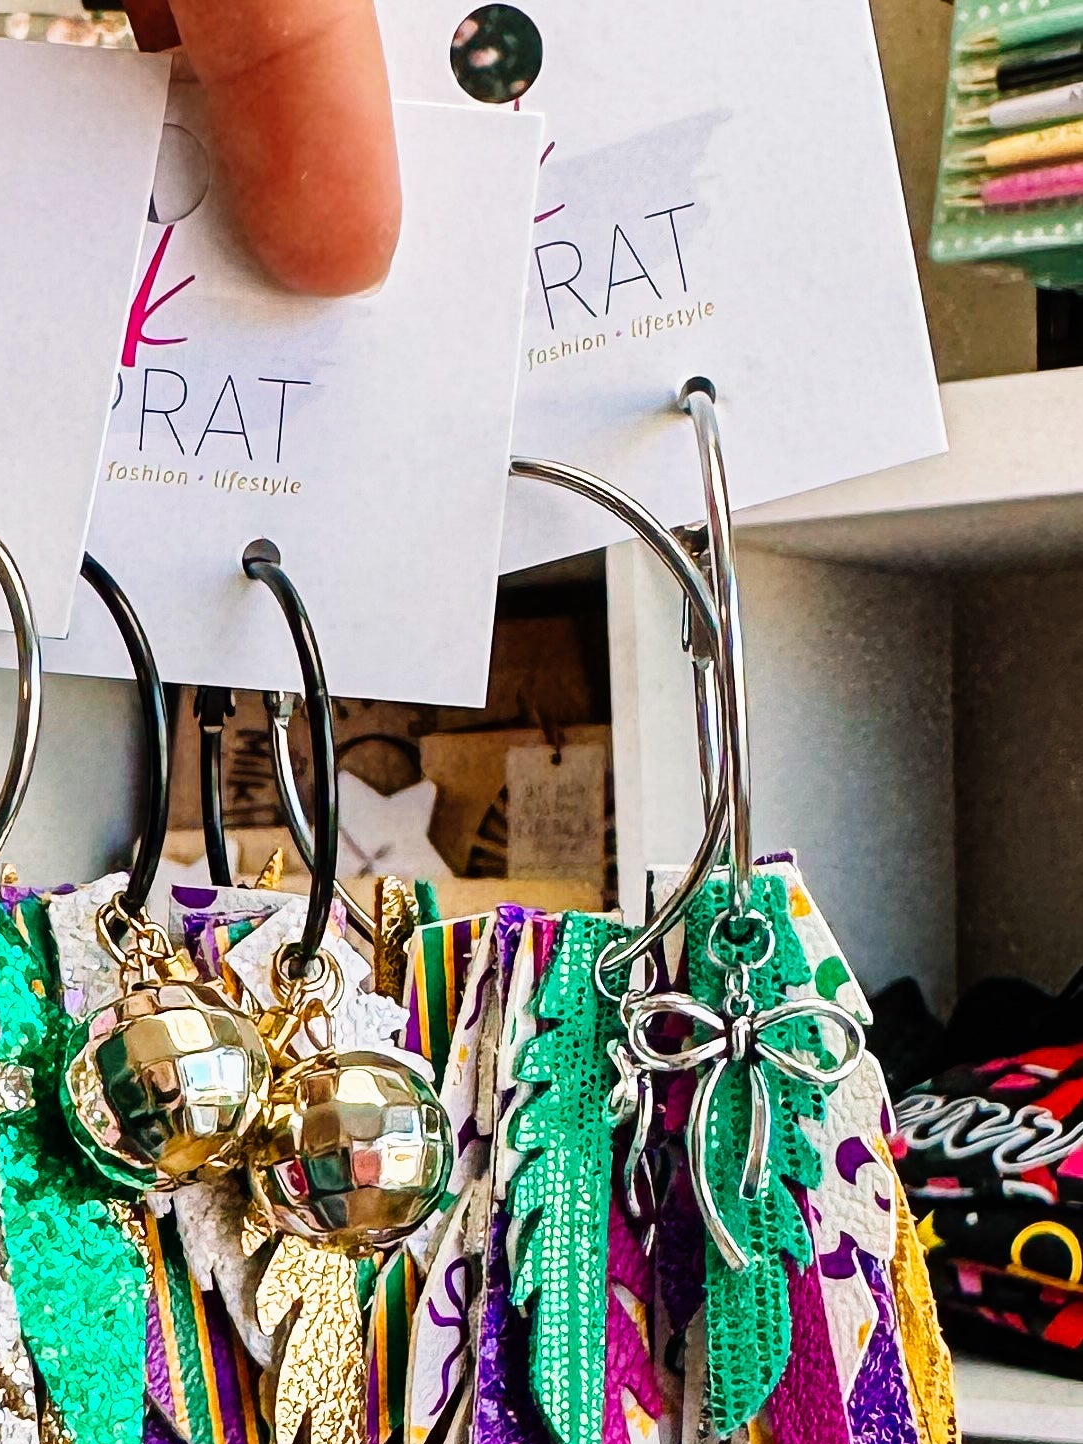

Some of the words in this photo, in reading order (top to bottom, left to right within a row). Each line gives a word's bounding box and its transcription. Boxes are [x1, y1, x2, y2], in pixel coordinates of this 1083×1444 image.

[533, 202, 695, 330] RAT
[527, 332, 607, 372] fashion
[630, 300, 716, 339] lifestyle
[112, 367, 312, 464] RAT
[105, 460, 189, 486] fashion
[213, 468, 302, 496] lifestyle
